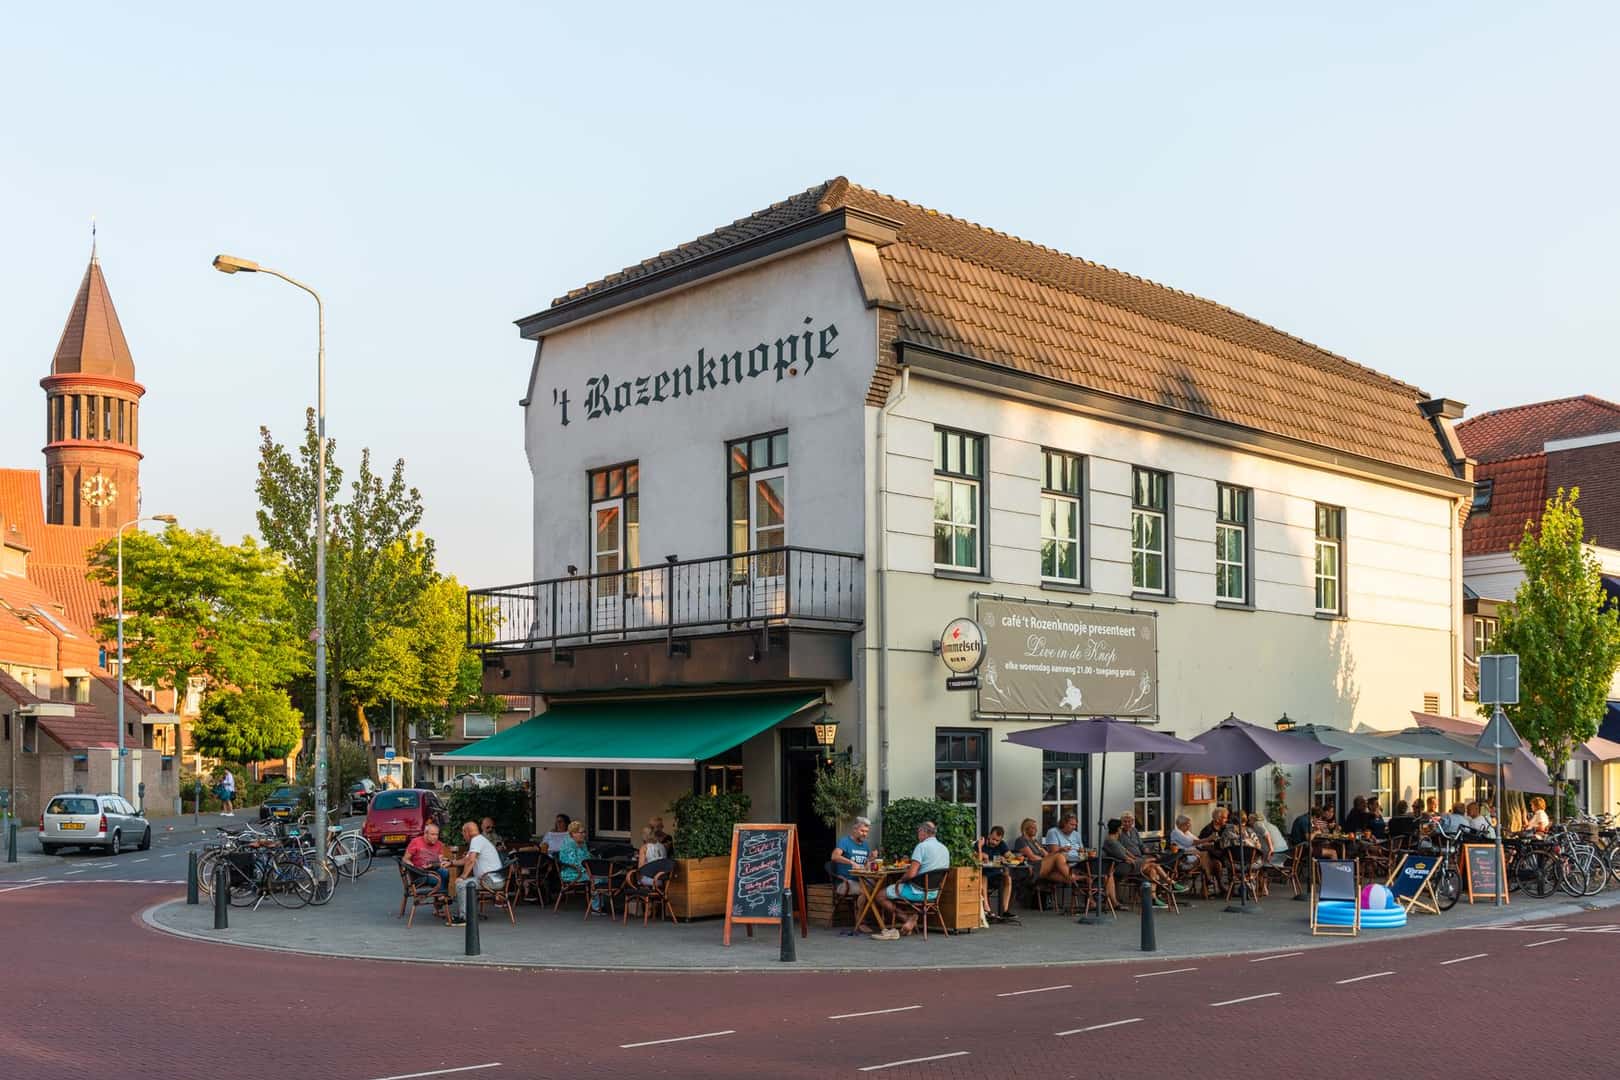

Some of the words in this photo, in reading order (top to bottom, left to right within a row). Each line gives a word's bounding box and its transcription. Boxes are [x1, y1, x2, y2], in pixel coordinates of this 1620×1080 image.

[552, 387, 572, 427] 't
[584, 315, 840, 421] Rozenknopje
[1002, 615, 1021, 628] café
[1022, 616, 1029, 628] 't
[1031, 617, 1088, 635] Rozenknopje
[1089, 626, 1136, 637] presenteert
[1024, 634, 1055, 657] Live
[1056, 648, 1067, 658] in
[1069, 644, 1081, 660] de
[1019, 663, 1051, 674] woensdag
